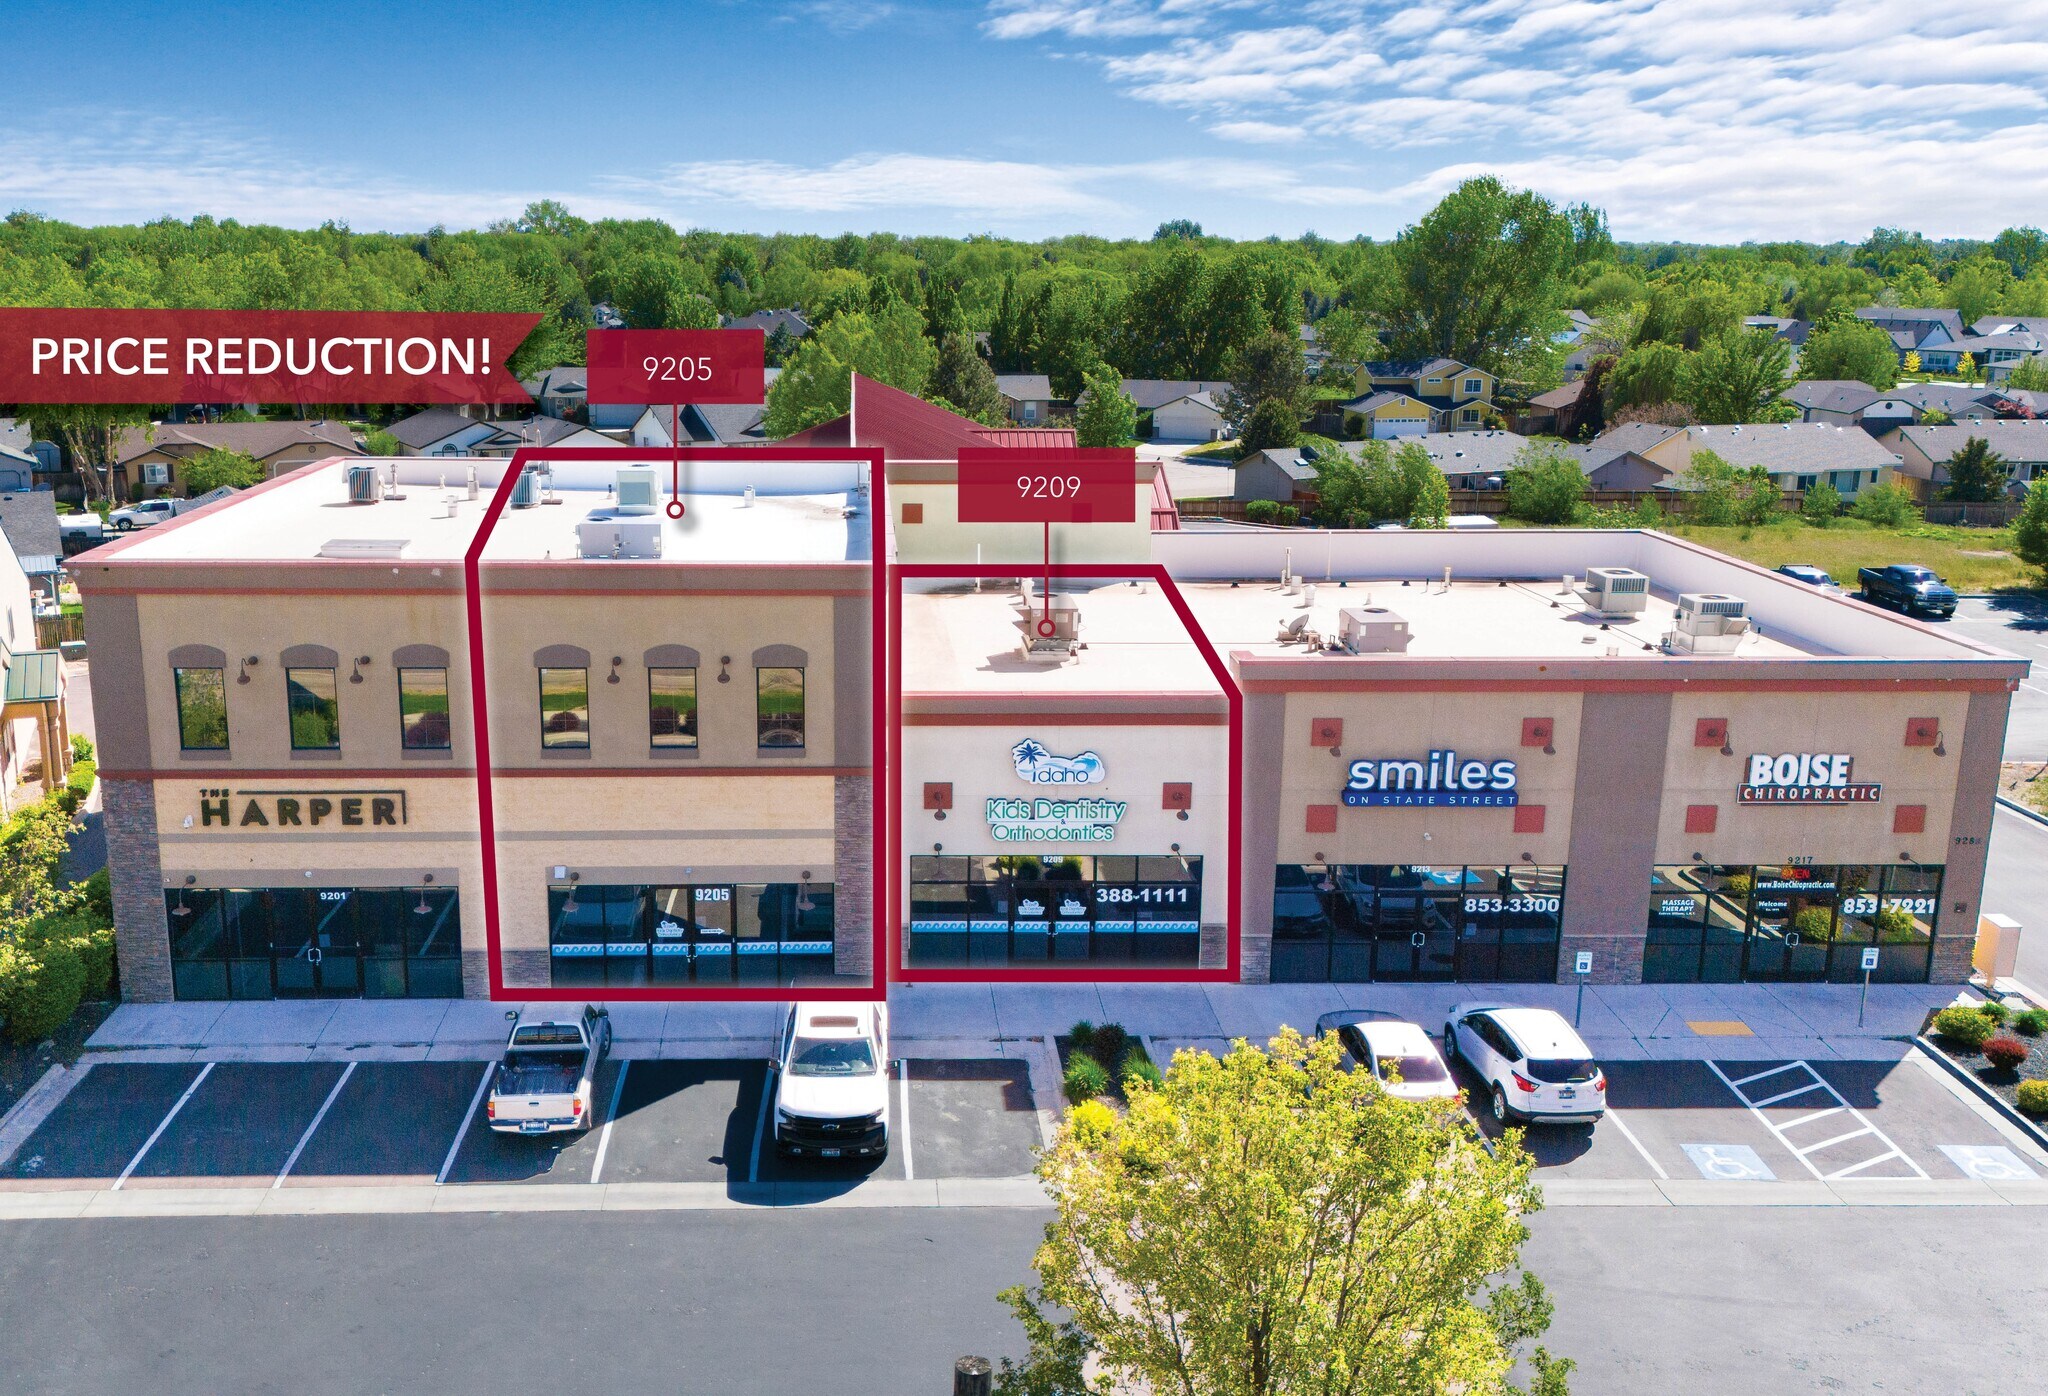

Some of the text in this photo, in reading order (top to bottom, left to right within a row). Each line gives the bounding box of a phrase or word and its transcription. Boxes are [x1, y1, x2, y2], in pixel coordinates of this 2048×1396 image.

[1349, 751, 1517, 790] smiles
[1749, 752, 1851, 787] BOISE
[200, 788, 230, 798] THE
[1743, 787, 1878, 800] CHIROPRACTIC
[1348, 796, 1516, 805] ON STATE STREET
[200, 798, 397, 827] HARPER
[988, 801, 1126, 823] Kids Dentistry
[993, 824, 1114, 841] Orthodontics
[1042, 855, 1064, 864] 9209
[1787, 856, 1814, 865] 9217
[1411, 865, 1431, 873] 9213
[320, 891, 347, 901] 9201
[695, 888, 730, 902] 9205
[1096, 888, 1188, 903] 388-1111
[1464, 898, 1560, 913] 853-3300
